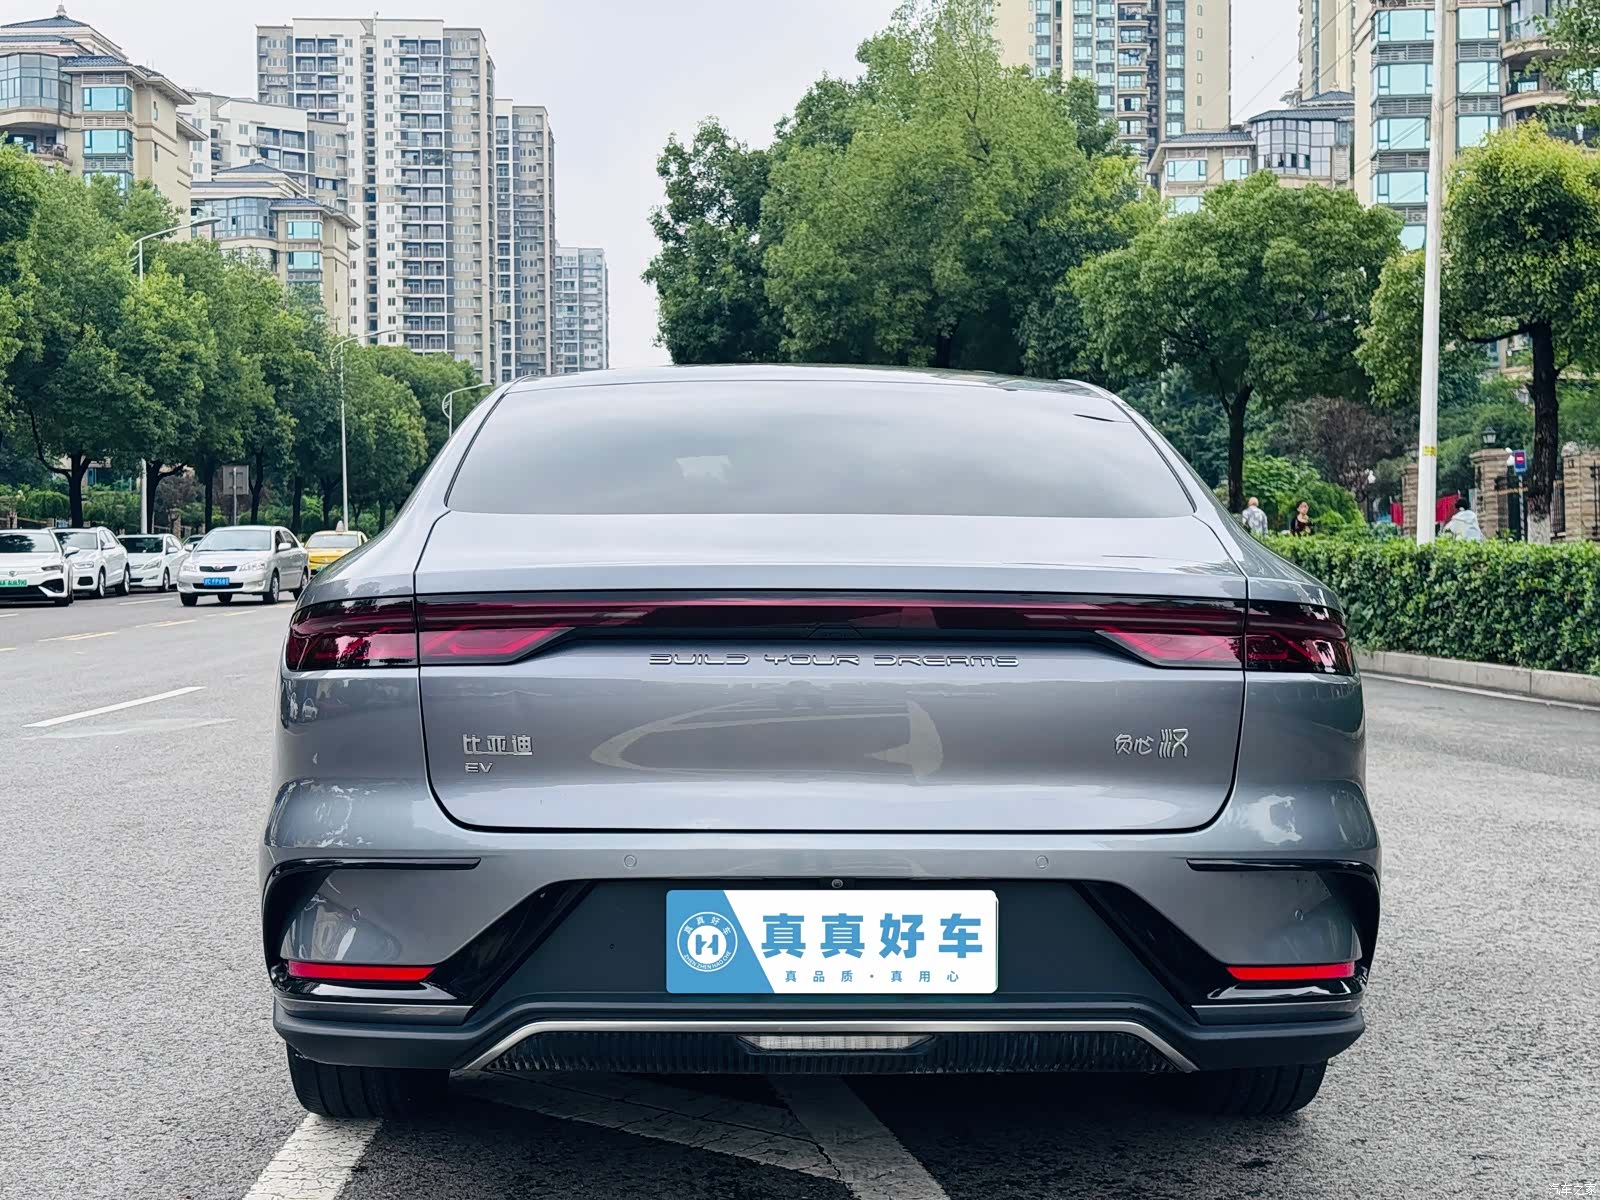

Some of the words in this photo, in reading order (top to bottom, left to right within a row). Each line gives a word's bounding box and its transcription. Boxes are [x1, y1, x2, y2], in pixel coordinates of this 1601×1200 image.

[649, 653, 750, 665] BUILD
[764, 653, 859, 666] YOUR
[873, 654, 1020, 666] DREAMS
[462, 733, 533, 756] 比亚迪
[465, 762, 493, 773] EV
